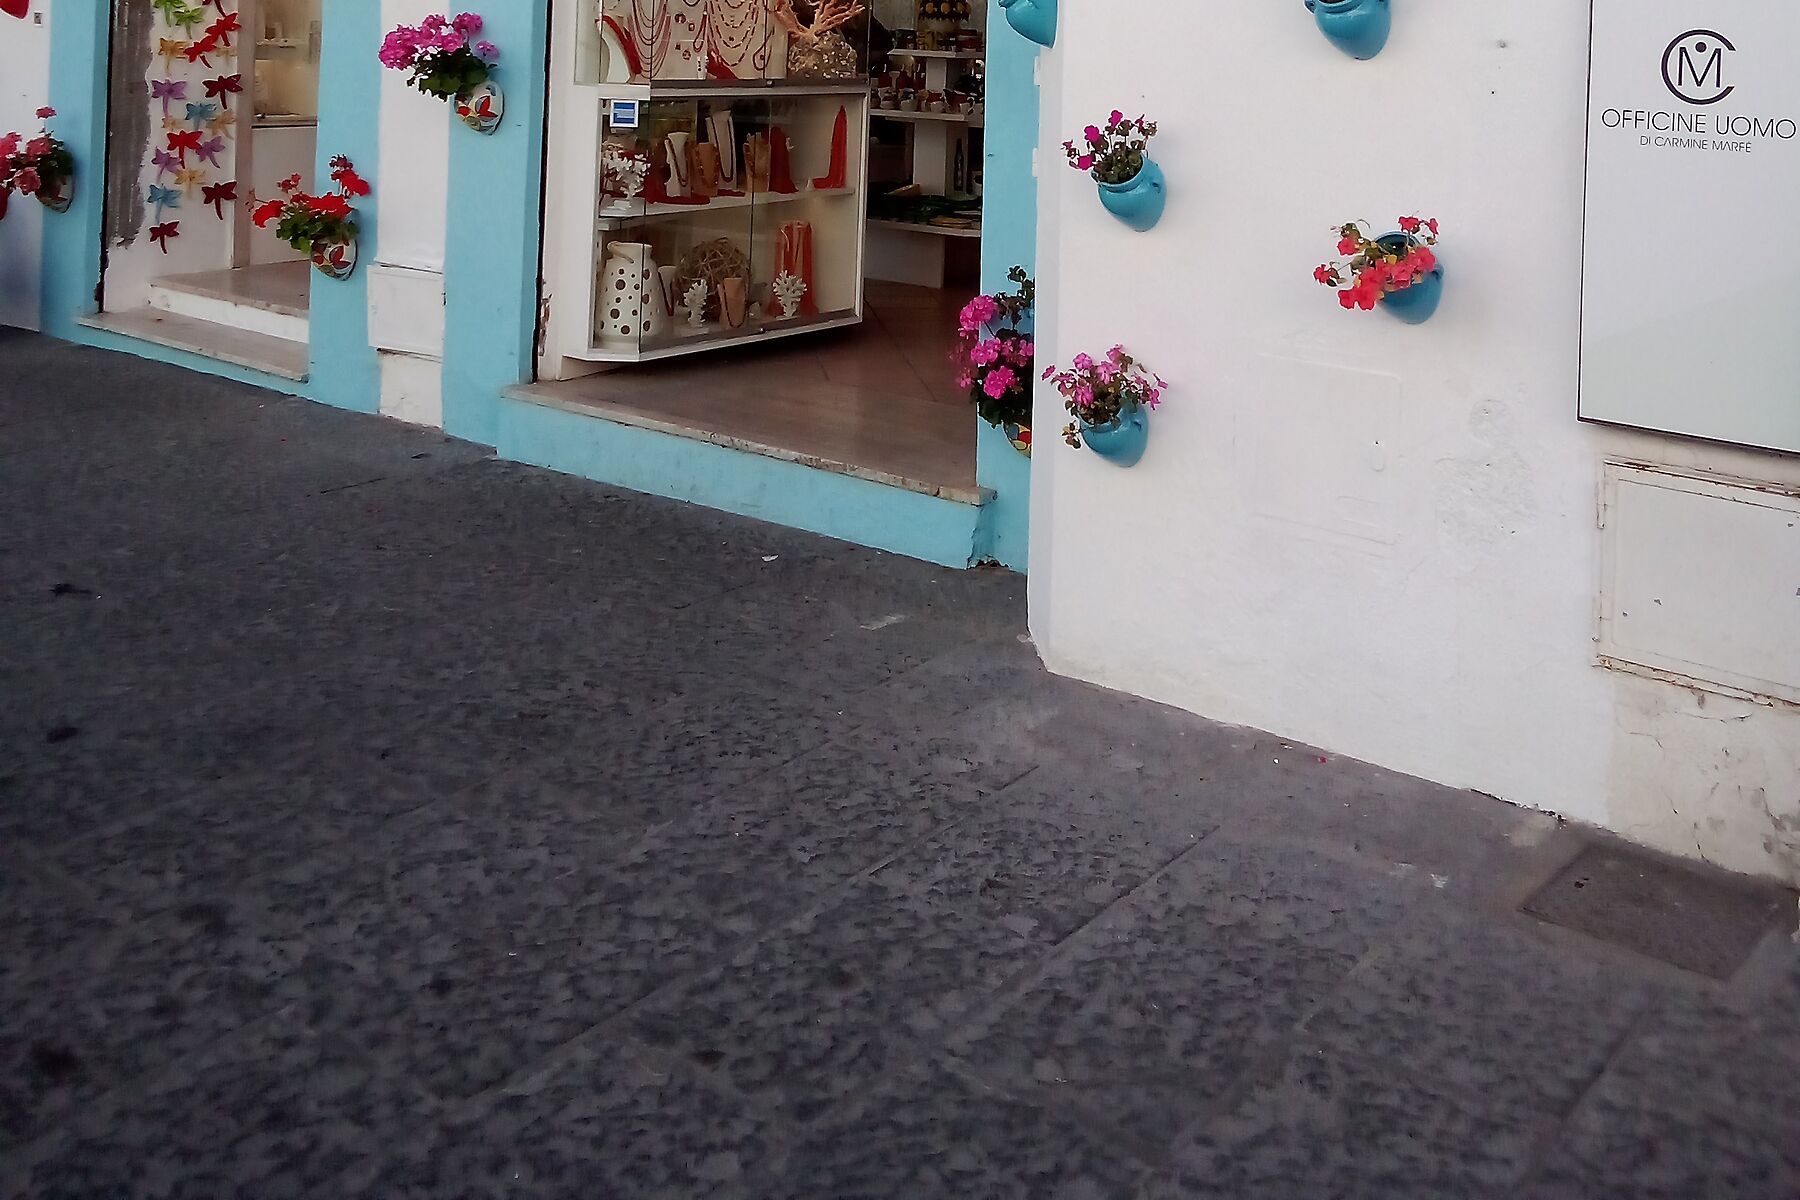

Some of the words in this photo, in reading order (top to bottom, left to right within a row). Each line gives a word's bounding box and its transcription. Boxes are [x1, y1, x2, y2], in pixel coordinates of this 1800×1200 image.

[1602, 108, 1707, 133] OFFICINE
[1716, 115, 1797, 139] UOMO
[1640, 135, 1651, 146] DI
[1654, 136, 1708, 150] CARMINE
